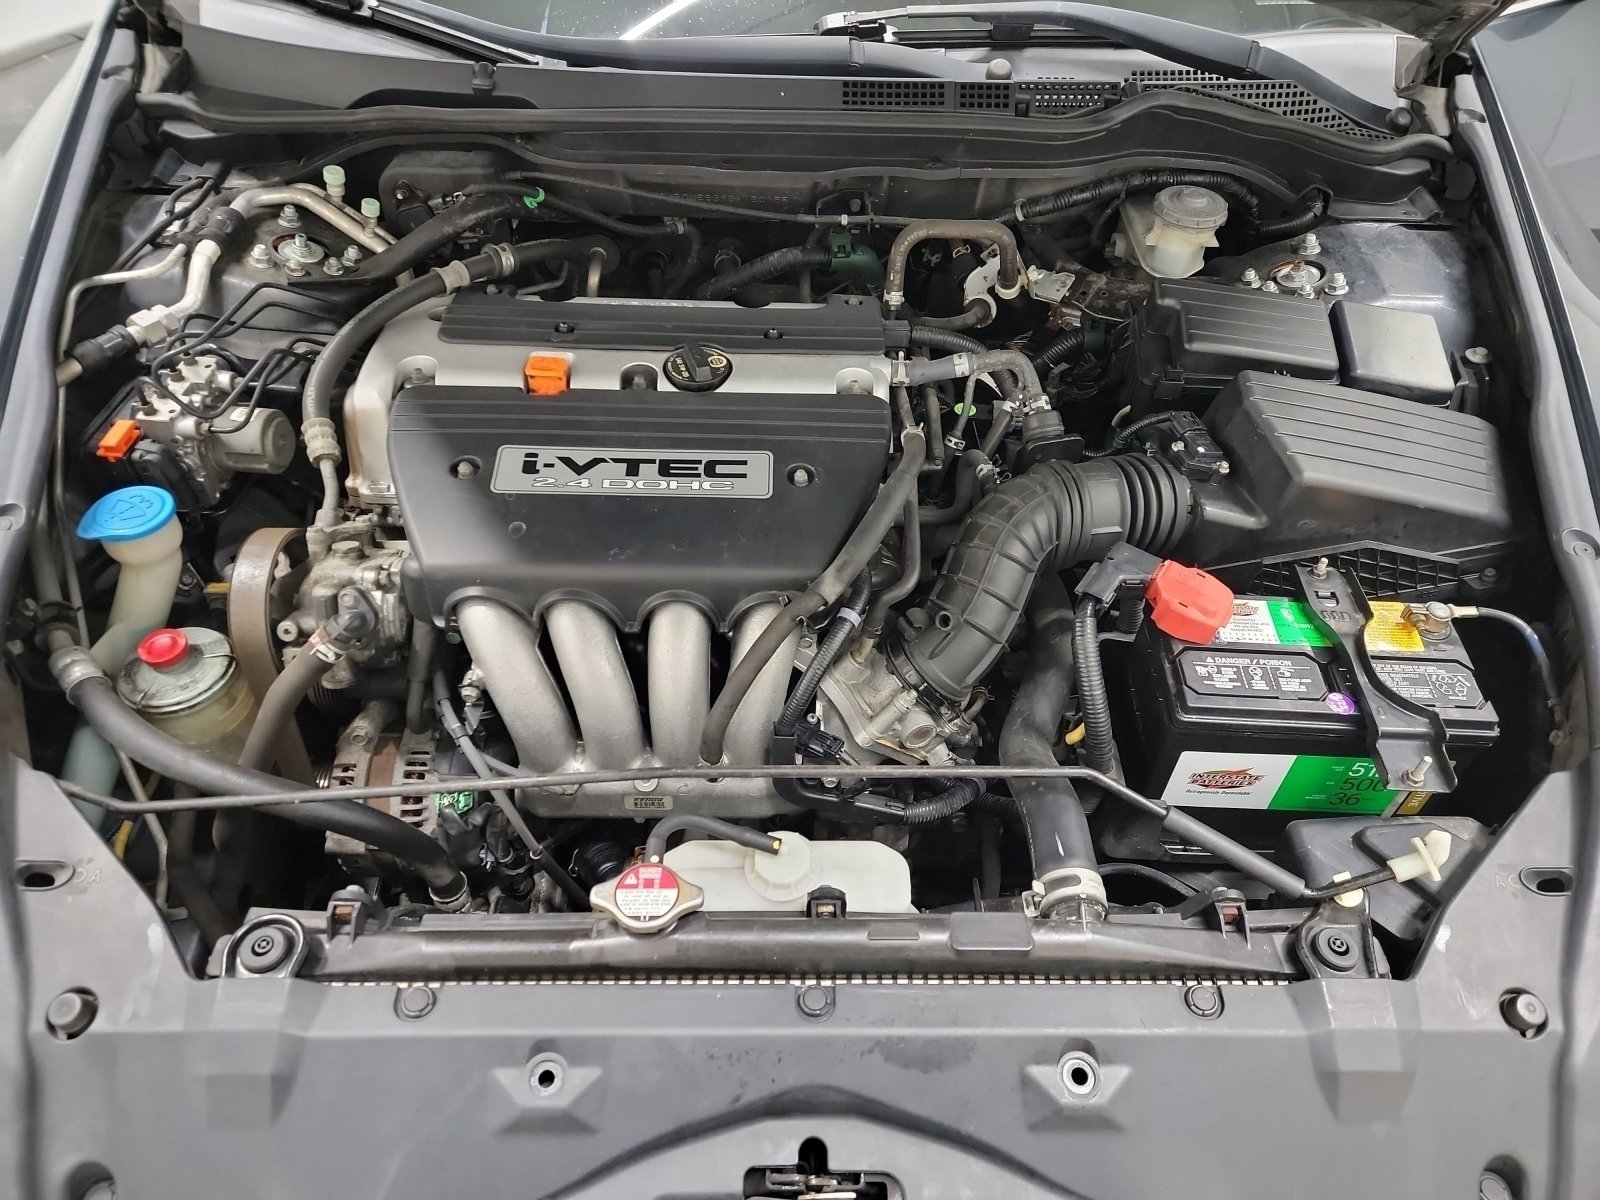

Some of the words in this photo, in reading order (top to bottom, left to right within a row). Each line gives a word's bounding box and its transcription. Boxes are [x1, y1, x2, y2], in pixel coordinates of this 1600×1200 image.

[521, 452, 748, 478] i-VTEC
[532, 477, 593, 488] 2.4
[601, 479, 735, 491] DOHC
[1214, 656, 1251, 665] DANGER
[1259, 658, 1293, 666] POISON
[1190, 772, 1264, 781] INTERSTATE
[1329, 792, 1361, 806] 36
